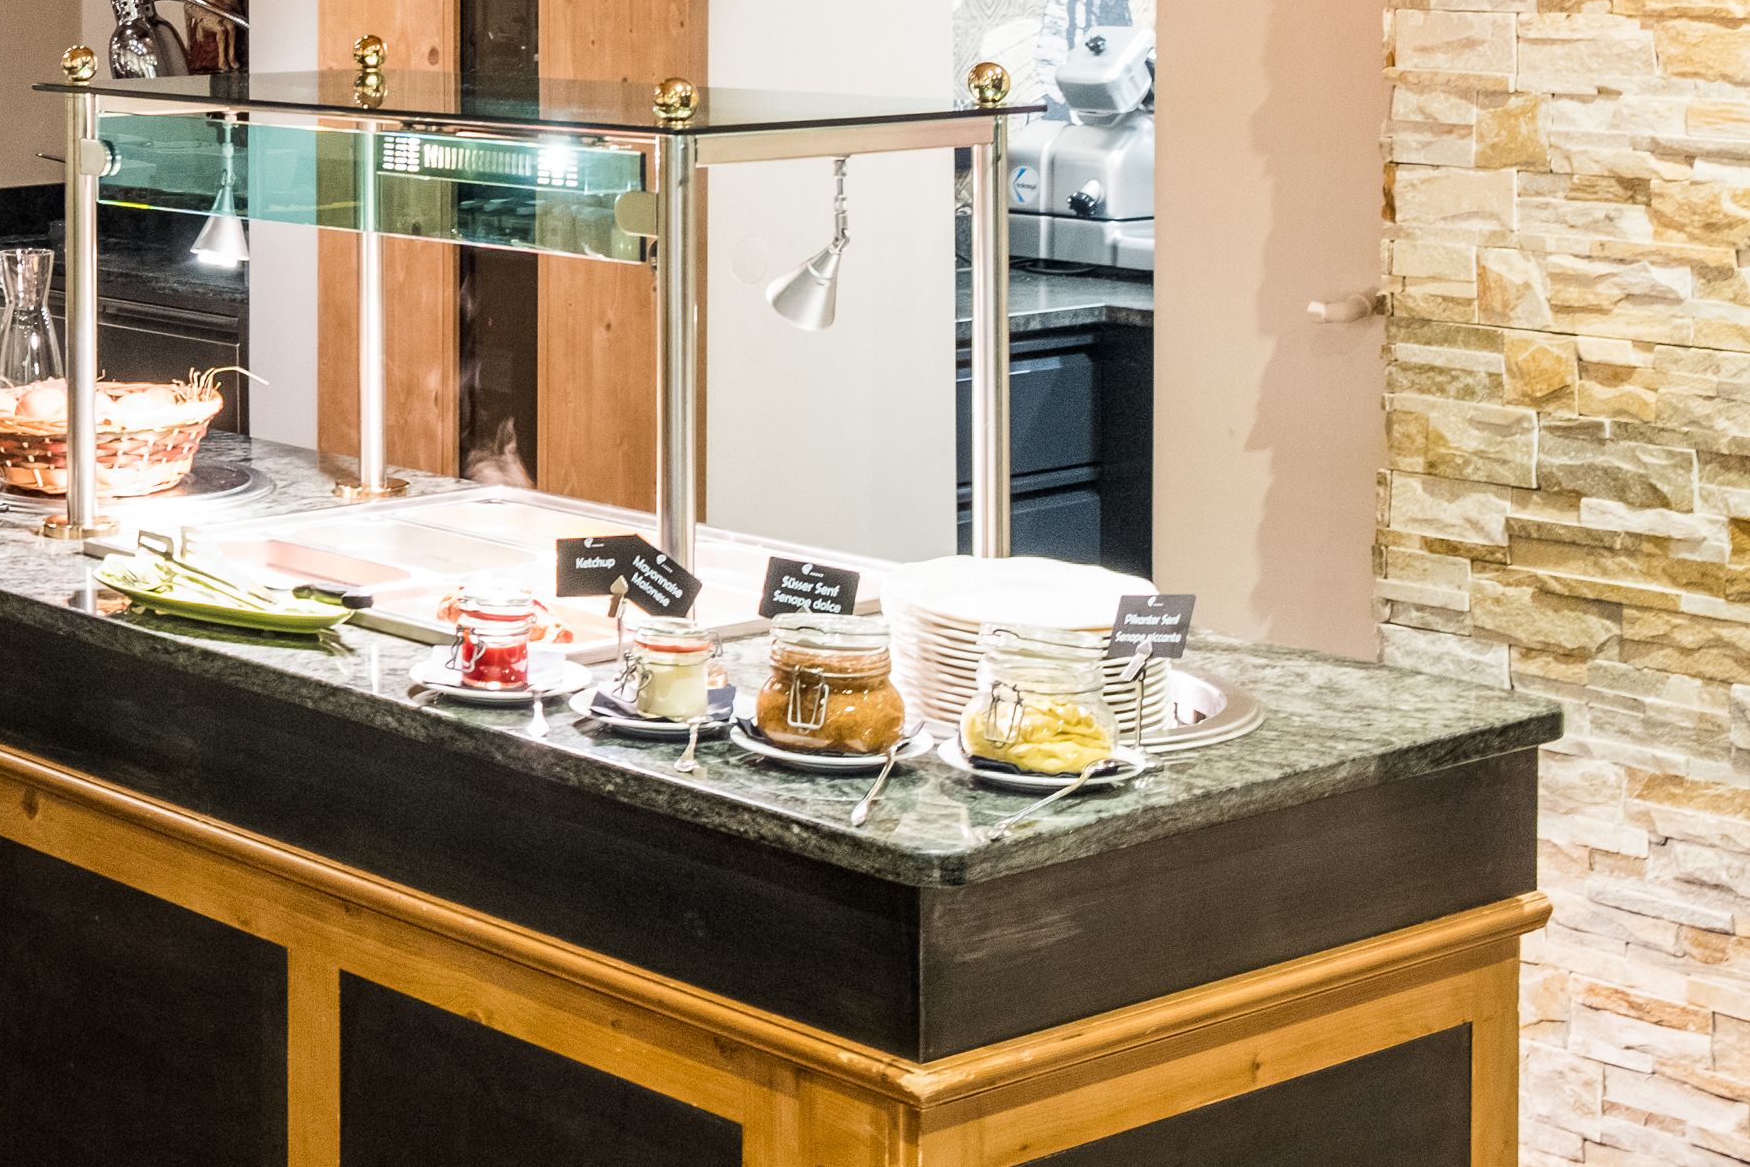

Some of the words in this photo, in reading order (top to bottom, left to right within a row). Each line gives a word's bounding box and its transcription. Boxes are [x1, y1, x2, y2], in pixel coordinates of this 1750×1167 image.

[575, 555, 616, 569] Ketchup
[630, 572, 671, 607] Maionese
[632, 555, 683, 599] Mayonnaise
[814, 581, 840, 598] Senf
[773, 589, 812, 608] Senape
[813, 598, 842, 614] dolce
